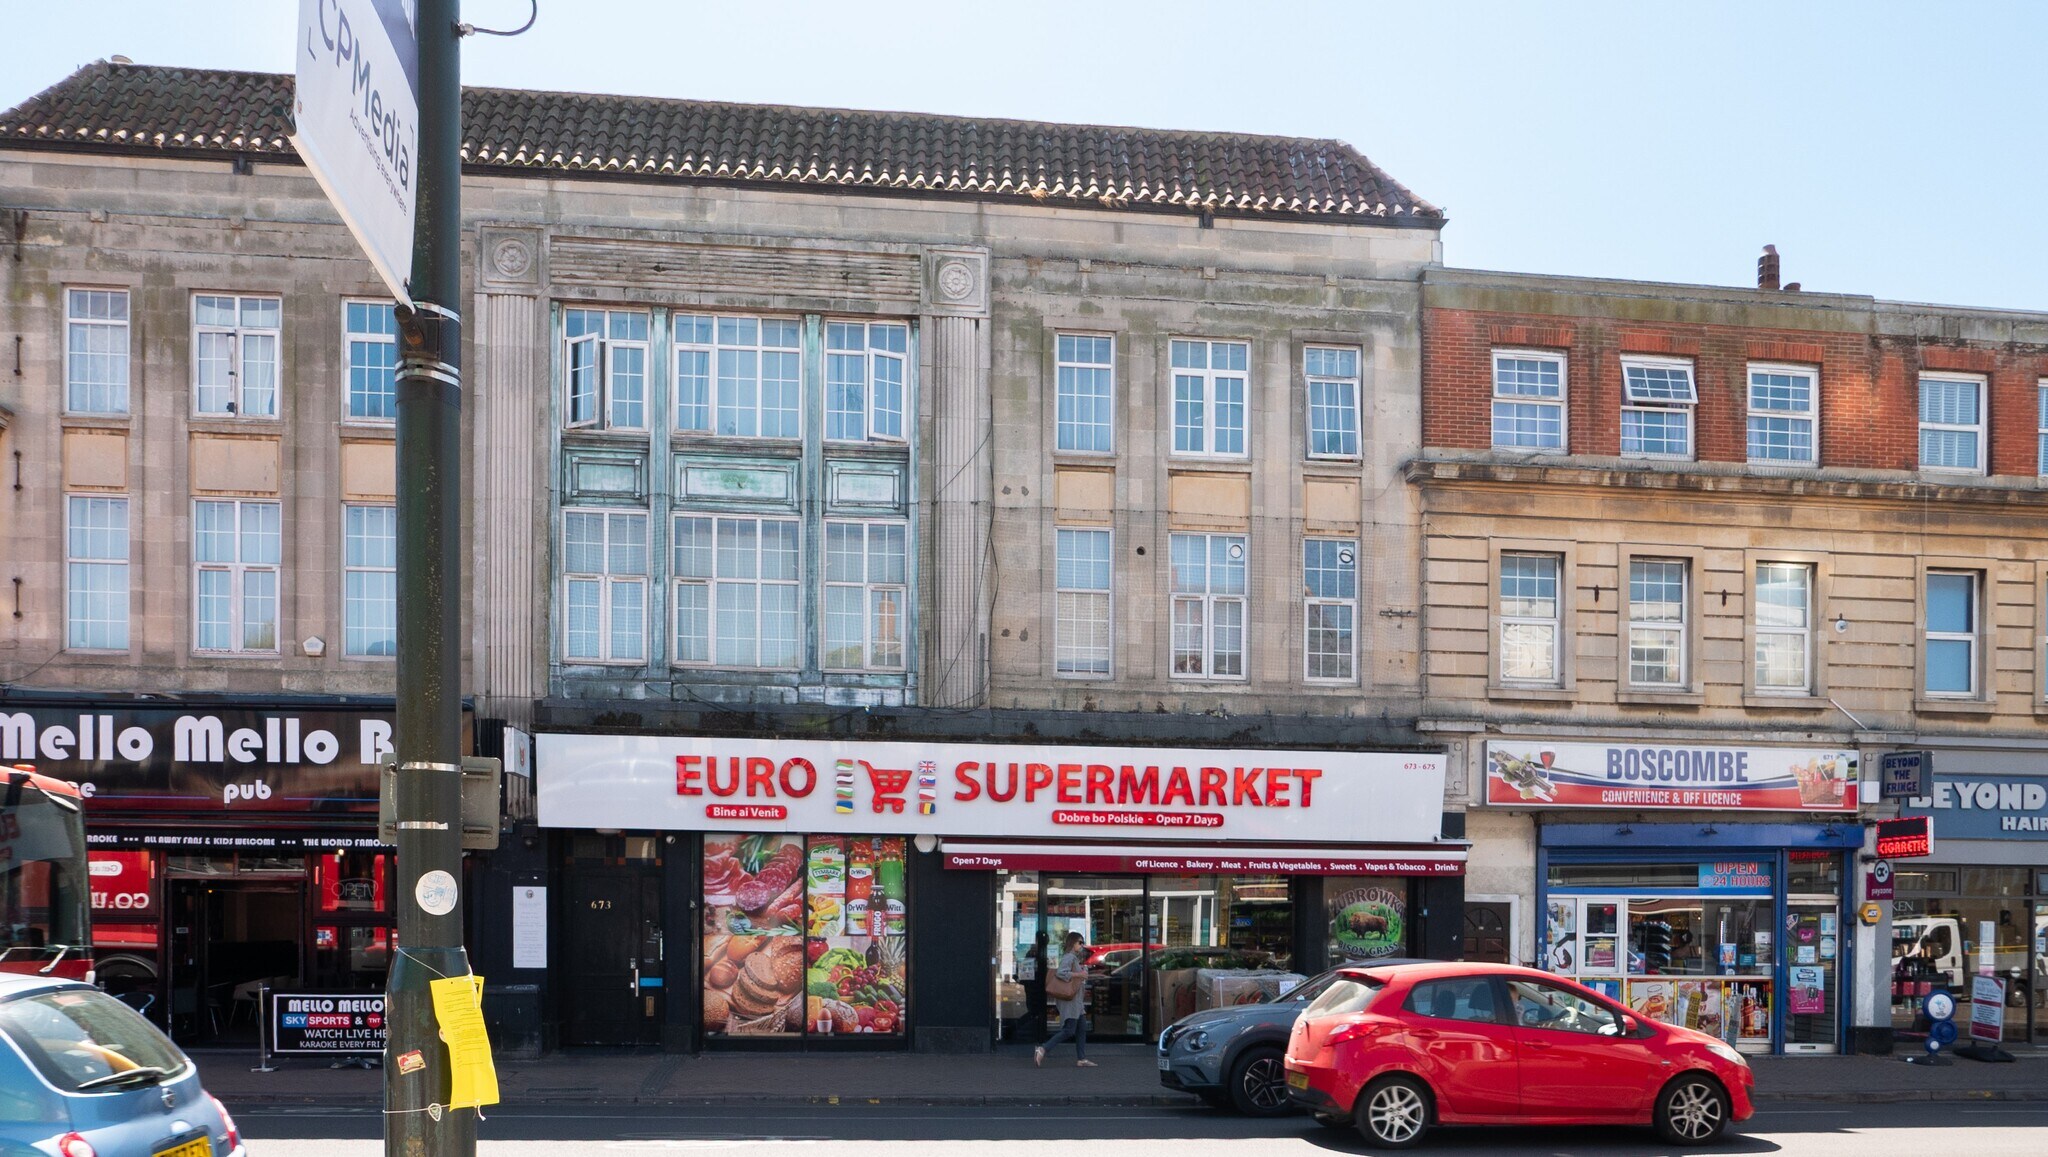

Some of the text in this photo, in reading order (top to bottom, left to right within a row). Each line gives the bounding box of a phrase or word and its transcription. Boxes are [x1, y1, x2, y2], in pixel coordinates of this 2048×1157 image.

[0, 712, 395, 765] Mello Mello B
[1607, 748, 1749, 783] BOSCOMBE
[1886, 756, 1920, 769] BEYOND
[1894, 770, 1911, 779] THE
[676, 755, 1323, 808] EURO SUPERMARKET
[1886, 781, 1917, 793] FRINGE
[224, 779, 272, 804] pub
[1602, 790, 1742, 805] CONVENIENCE & OFF LICENCE
[1909, 782, 2047, 810] EYOND
[713, 806, 780, 818] Bine ai Venit
[1059, 812, 1090, 823] Dobre
[1092, 813, 1106, 823] bo
[1107, 813, 1144, 824] Polskie
[1156, 814, 1183, 826] Open
[1185, 815, 1192, 824] 7
[1194, 815, 1218, 827] Days
[2002, 816, 2048, 831] HAIR
[86, 835, 118, 843] RAOKE
[158, 836, 182, 845] AWAY
[183, 837, 202, 845] FANS
[213, 838, 233, 846] KIDS
[234, 838, 275, 846] WELCOME
[321, 839, 352, 847] WORLD
[354, 839, 390, 847] FAMO
[952, 856, 1002, 866] Open 7 Days
[1135, 860, 1148, 868] Off
[1149, 860, 1178, 868] Licence
[1186, 860, 1213, 870] Bakery
[1221, 861, 1241, 869] Meat
[1248, 861, 1271, 869] Fruits
[1279, 862, 1322, 871] Vegetables
[1330, 862, 1357, 870] Sweets
[1364, 862, 1388, 872] Vapes
[1395, 863, 1426, 871] Tobacco
[1714, 862, 1758, 874] OPEN
[1712, 875, 1770, 887] 24 HOURS
[331, 882, 376, 898] OPEN
[1871, 888, 1893, 896] payzone
[591, 900, 611, 909] 673
[873, 910, 883, 936] FRUGO
[1339, 941, 1399, 957] BISON GRASS
[288, 1000, 384, 1012] MELLO MELLO
[285, 1016, 306, 1024] SKY
[309, 1016, 350, 1025] SPORTS
[355, 1017, 363, 1025] &
[304, 1029, 387, 1038] WATCH LIVE HE
